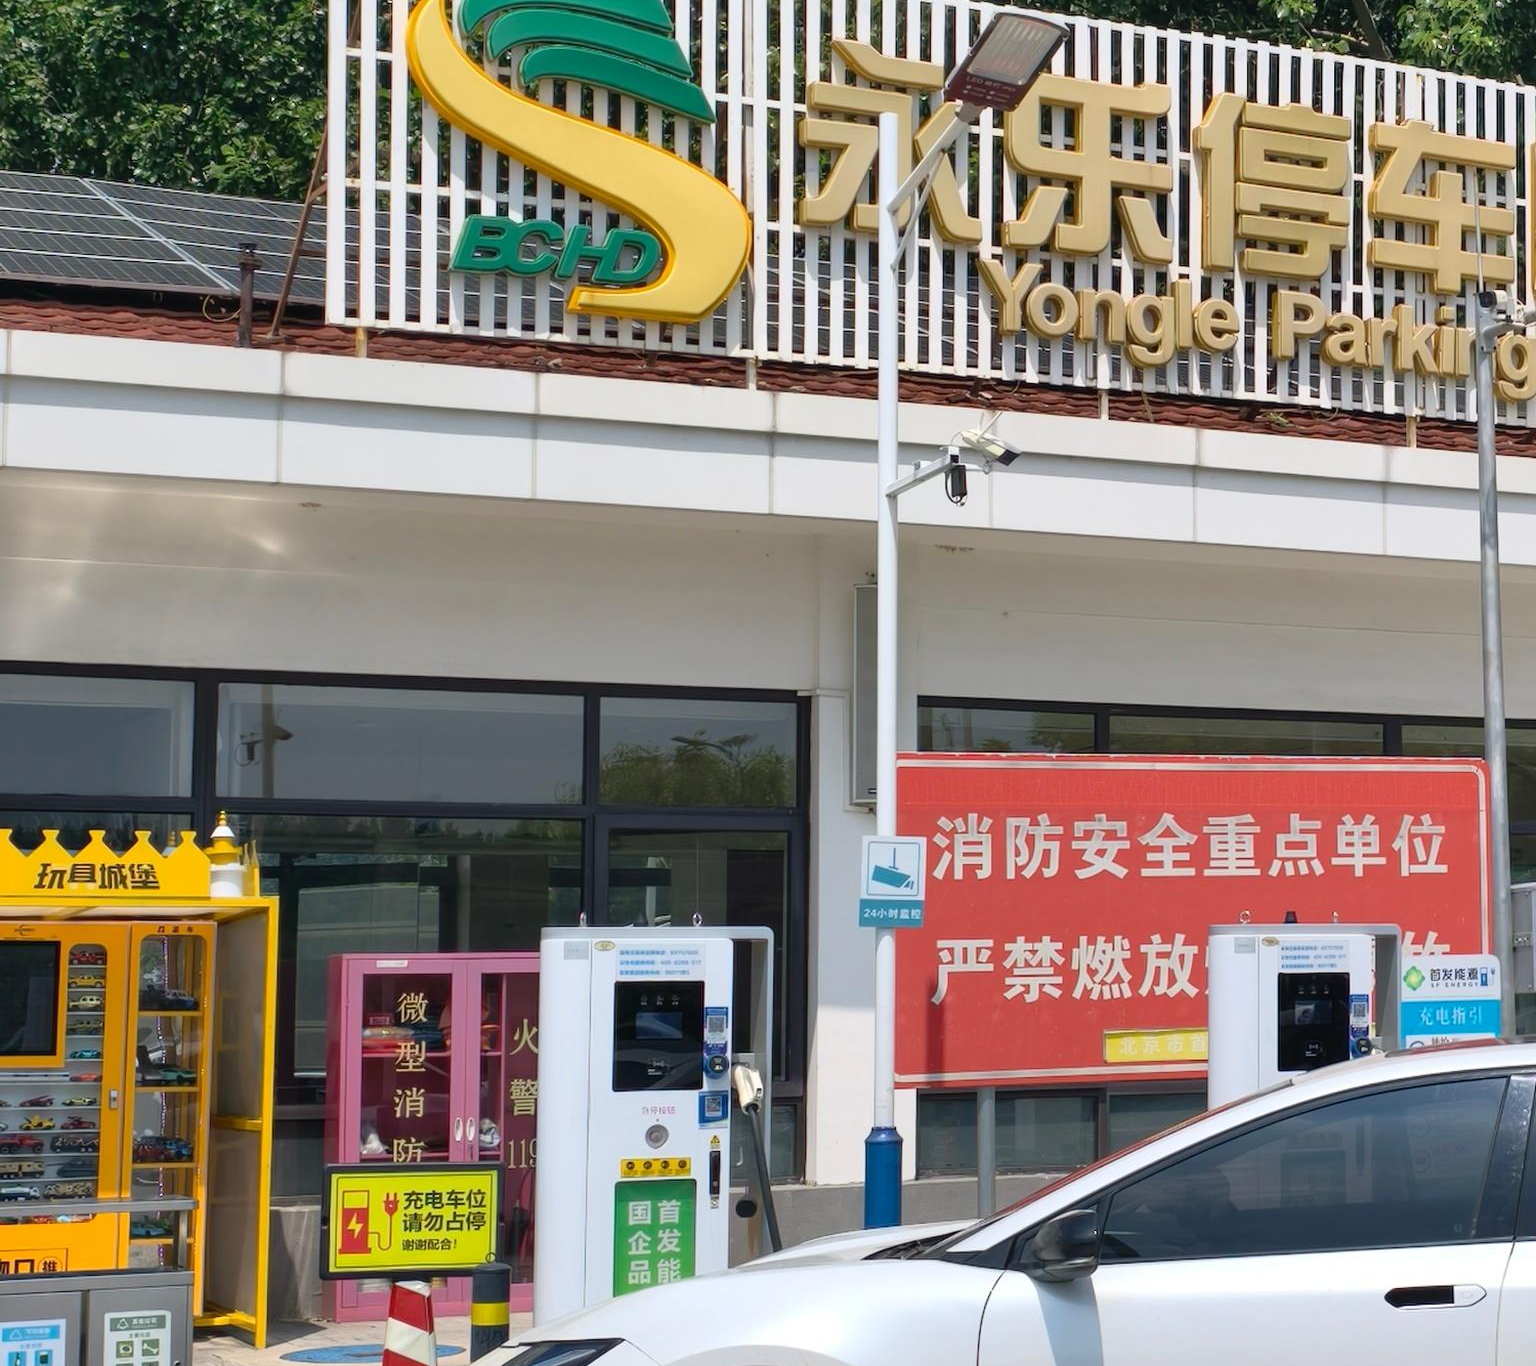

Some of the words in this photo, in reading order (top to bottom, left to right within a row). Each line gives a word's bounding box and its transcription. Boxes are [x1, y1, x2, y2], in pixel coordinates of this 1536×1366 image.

[450, 214, 661, 285] BCHD
[976, 257, 1240, 368] Yongle
[931, 812, 1448, 880] 消防安全重点单位
[33, 862, 160, 890] 玩具城堡
[863, 907, 922, 920] 24小时监控
[1430, 968, 1478, 981] 首发能源
[1420, 1006, 1482, 1026] 充电指引
[403, 1189, 487, 1210] 充电车位
[402, 1211, 487, 1233] 请勿占停
[402, 1238, 457, 1251] 谢谢配合!
